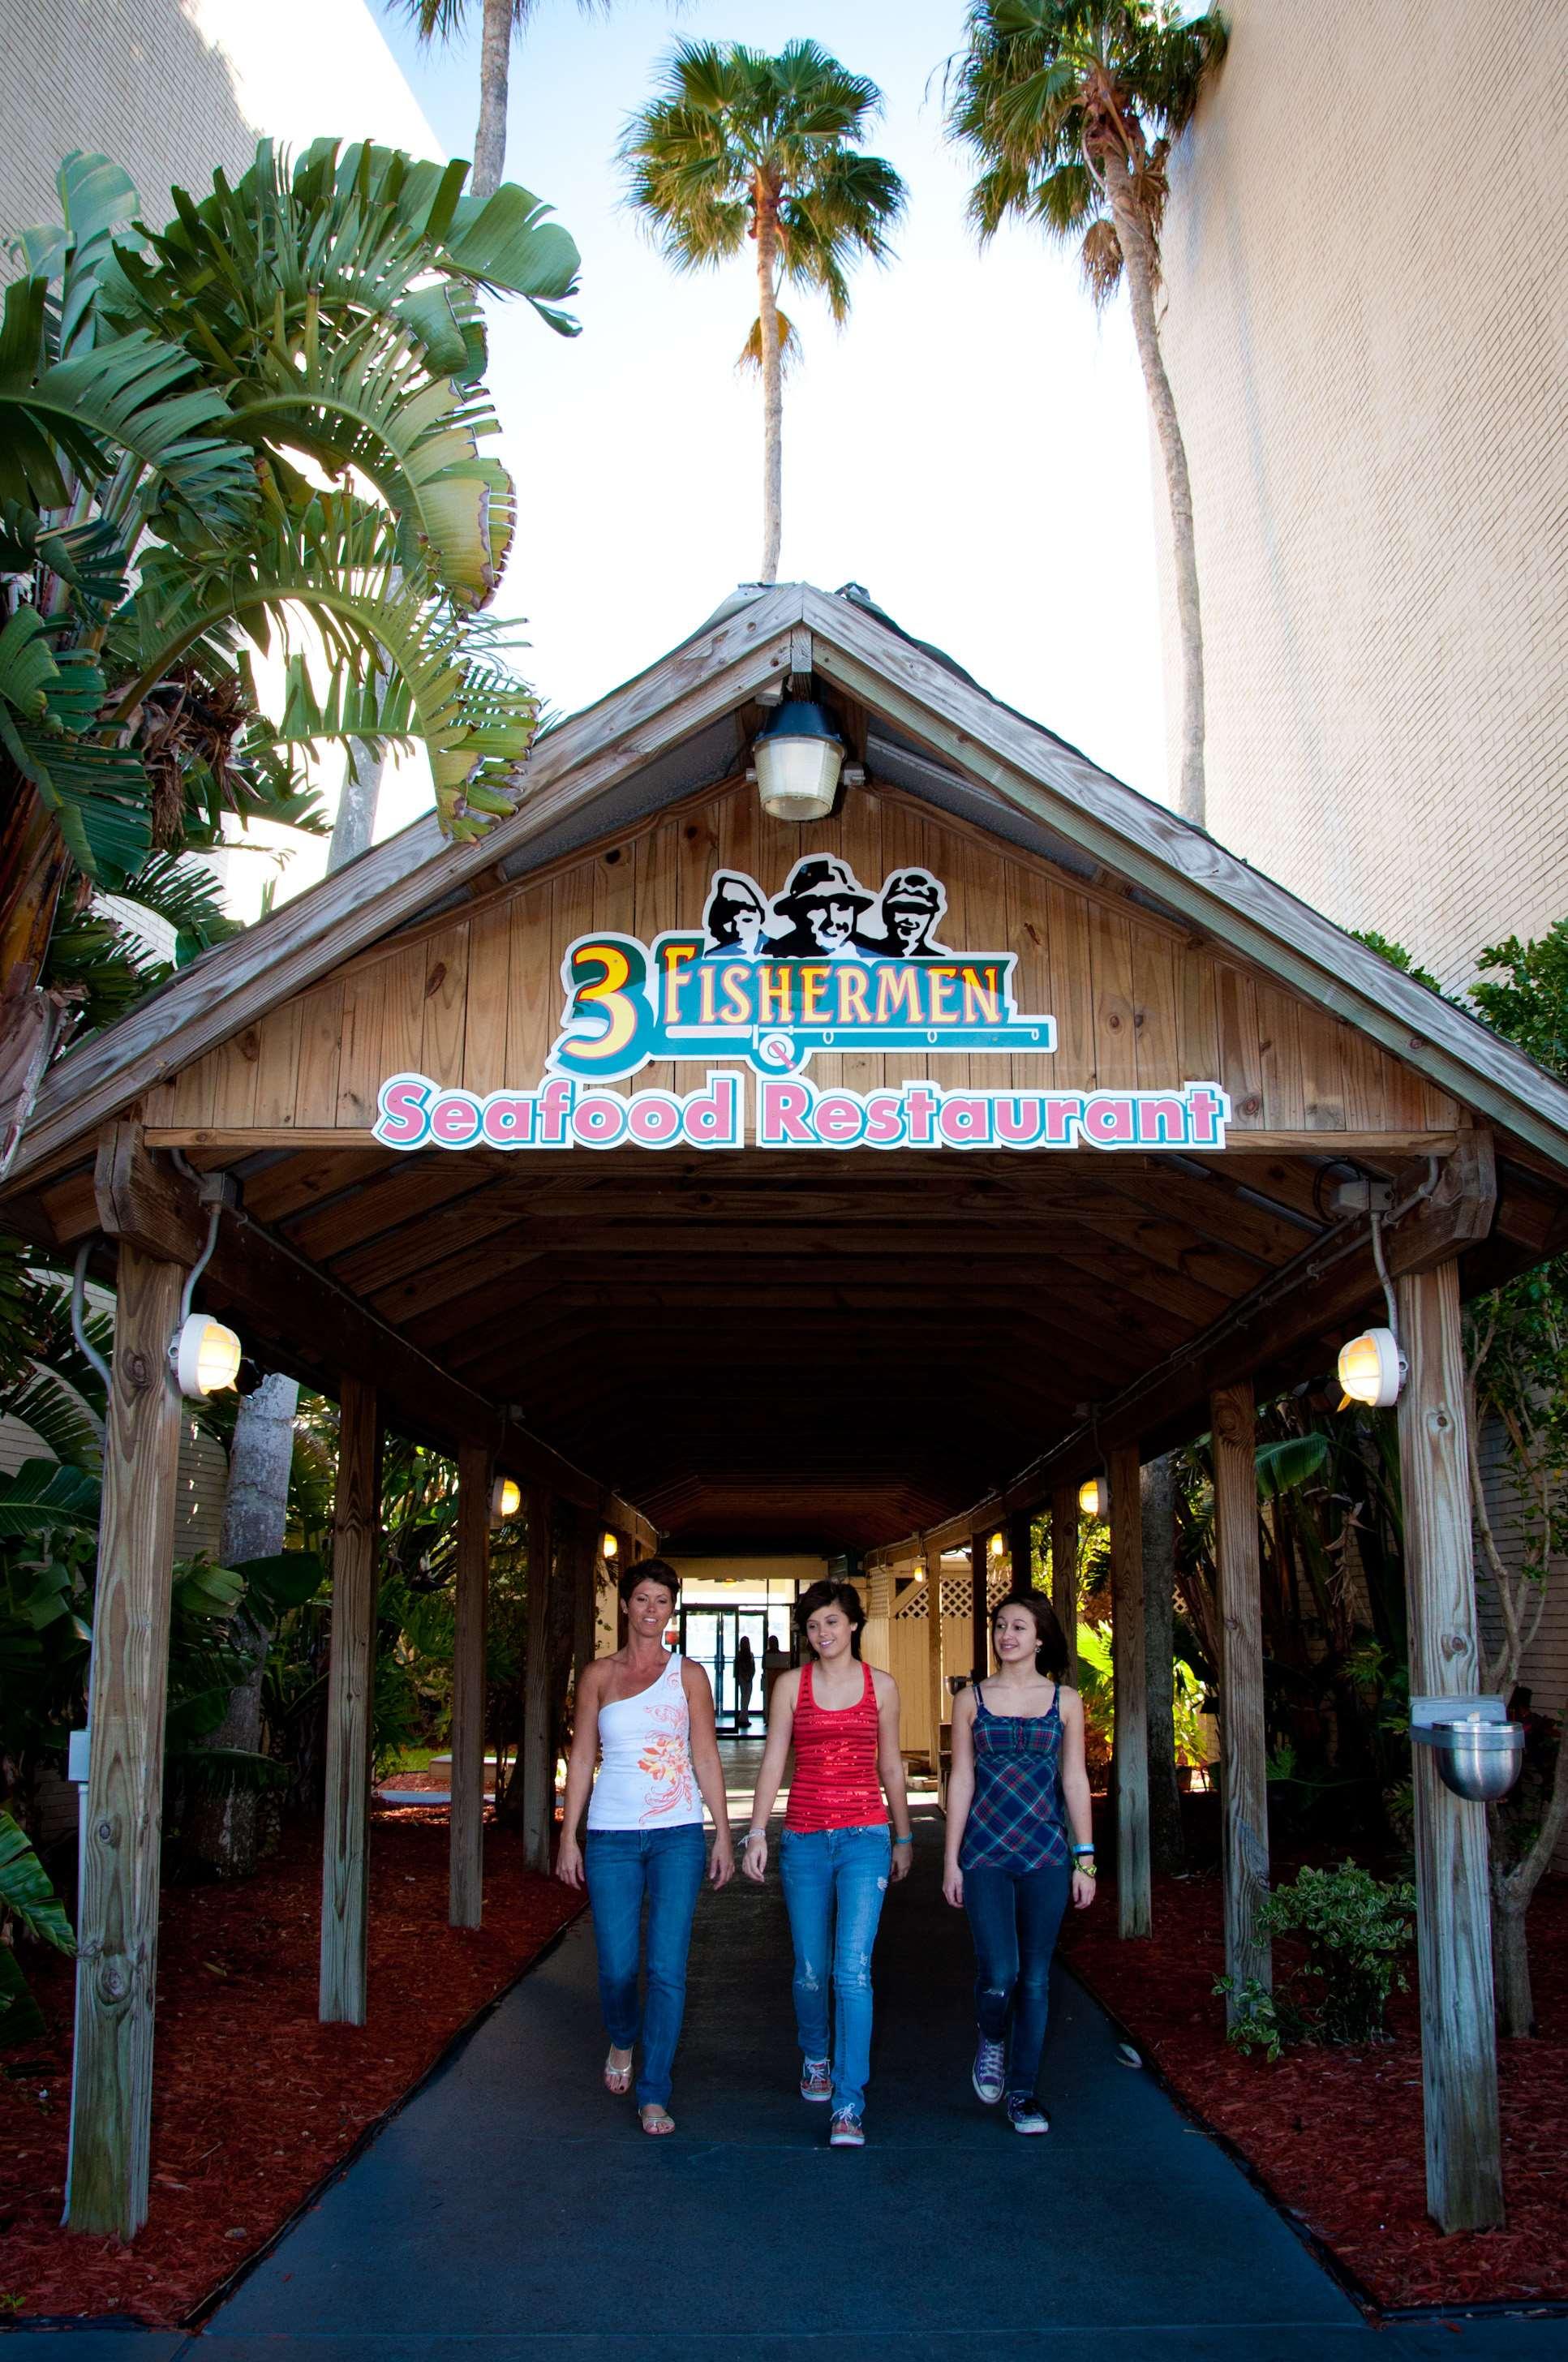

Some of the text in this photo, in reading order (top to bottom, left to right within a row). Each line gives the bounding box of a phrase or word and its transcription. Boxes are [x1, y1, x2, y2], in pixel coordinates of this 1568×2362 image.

[561, 944, 1003, 1060] 3 FISHERMEN
[376, 1079, 1222, 1143] Seafood Restaurant
